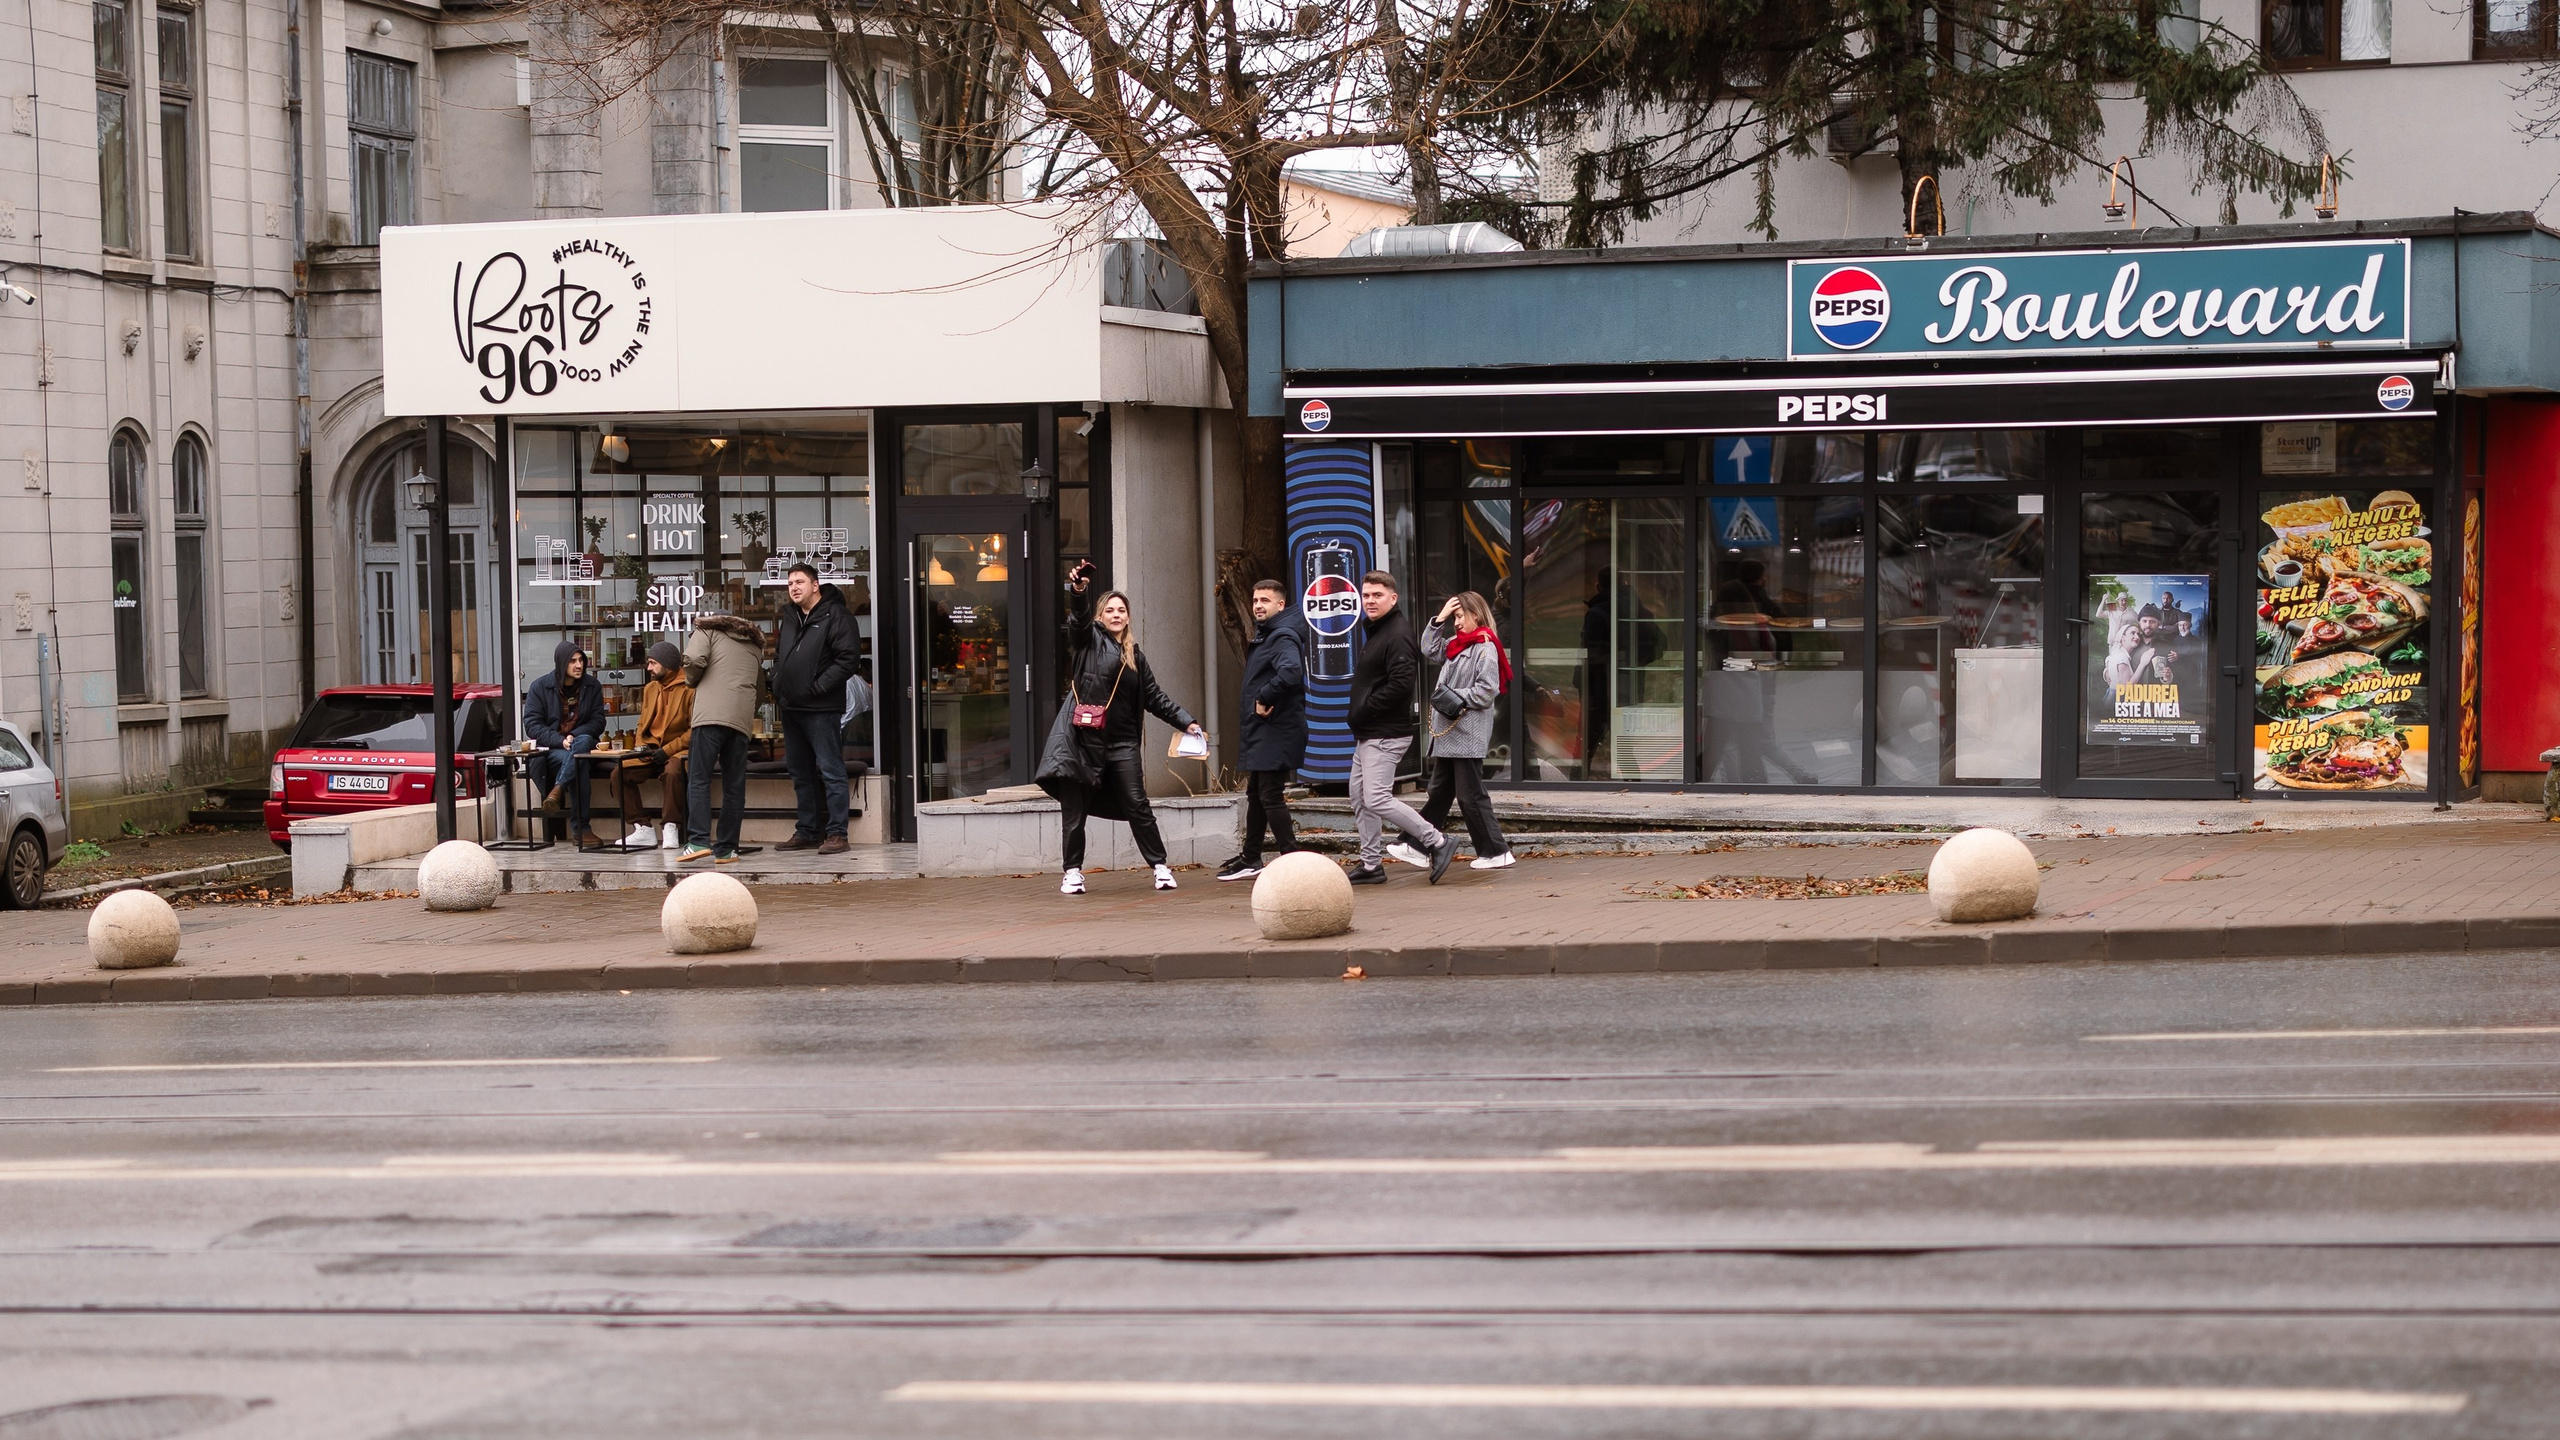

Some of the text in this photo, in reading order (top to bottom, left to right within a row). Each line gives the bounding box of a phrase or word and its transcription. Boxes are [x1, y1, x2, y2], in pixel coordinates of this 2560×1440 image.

[453, 251, 614, 363] Roots
[1815, 253, 2385, 344] PEPSI Boulevard
[552, 239, 651, 382] #HEALTHY IS THE NEW COOL
[478, 335, 557, 404] 96
[2380, 388, 2412, 397] PEPSI
[1303, 412, 1329, 420] PEPSI
[1778, 393, 1886, 422] PEPSI
[643, 503, 707, 525] DRINK
[2330, 503, 2421, 531] MENIU LA
[653, 529, 697, 550] HOT
[2330, 521, 2413, 548] ALEGERE
[646, 585, 705, 606] SHOP
[2269, 583, 2320, 605] FELIE
[1306, 598, 1357, 612] PEPSI
[2278, 601, 2329, 622] PIZZA
[634, 611, 714, 632] HEALT
[2115, 682, 2179, 703] PĂDUREA
[2340, 672, 2422, 695] SANDWICH
[2374, 689, 2412, 705] CALD
[2114, 702, 2180, 718] ESTE A MEA
[2268, 718, 2310, 738] PITA
[2267, 732, 2330, 754] KEBAB
[336, 777, 385, 790] IS 44 GLO
